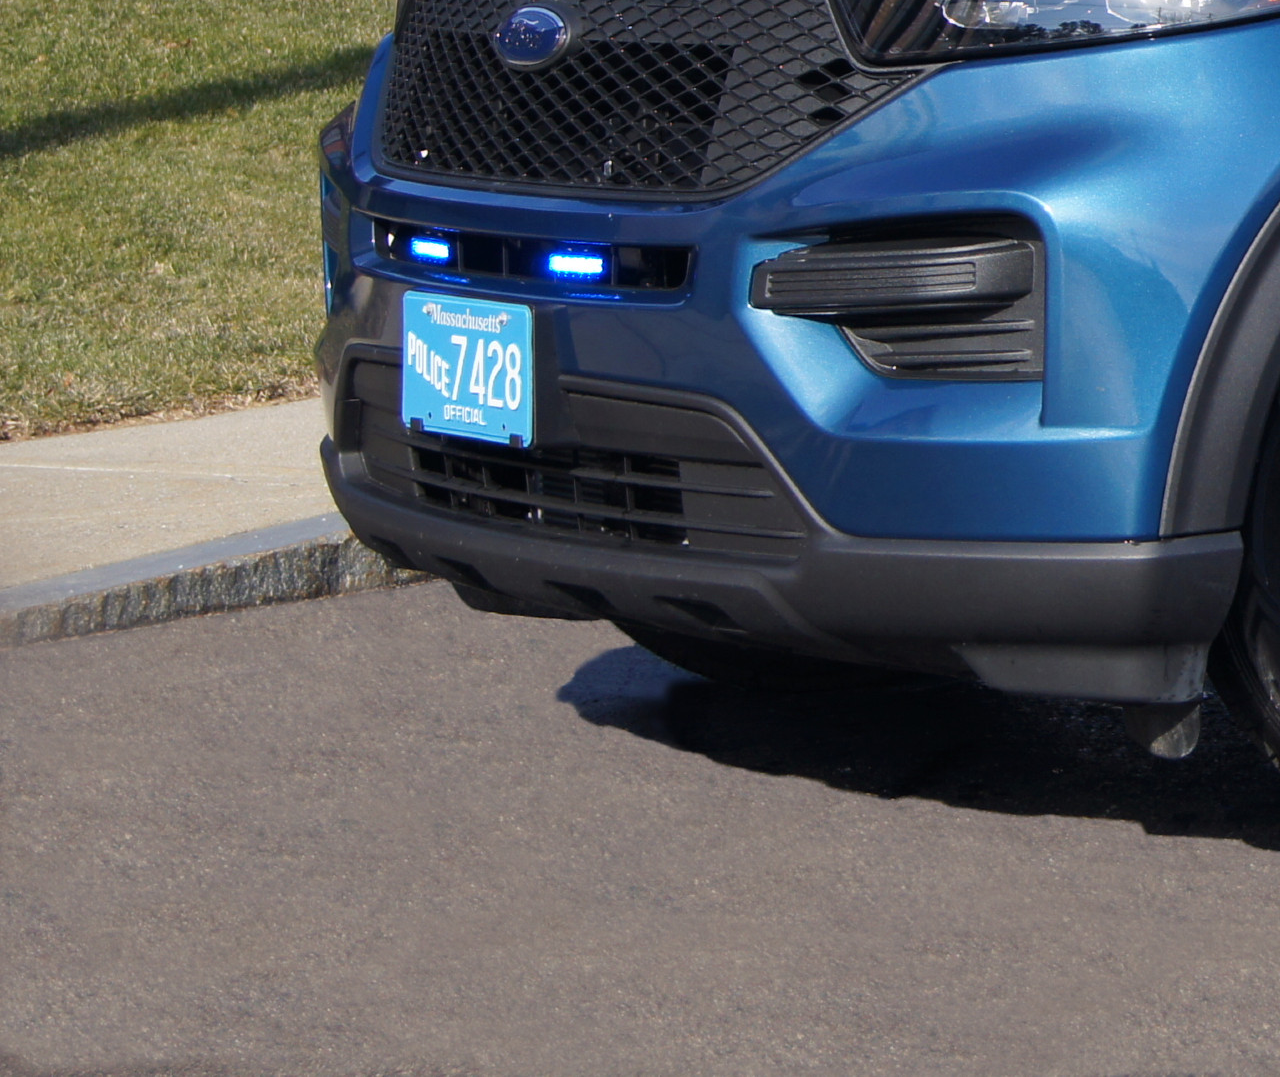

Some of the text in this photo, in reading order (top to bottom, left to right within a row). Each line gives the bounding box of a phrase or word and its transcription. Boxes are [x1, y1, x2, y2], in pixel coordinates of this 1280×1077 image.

[432, 304, 501, 333] Massachusetts
[408, 331, 521, 410] POLICE 7428
[444, 404, 487, 426] OFFICIAL
